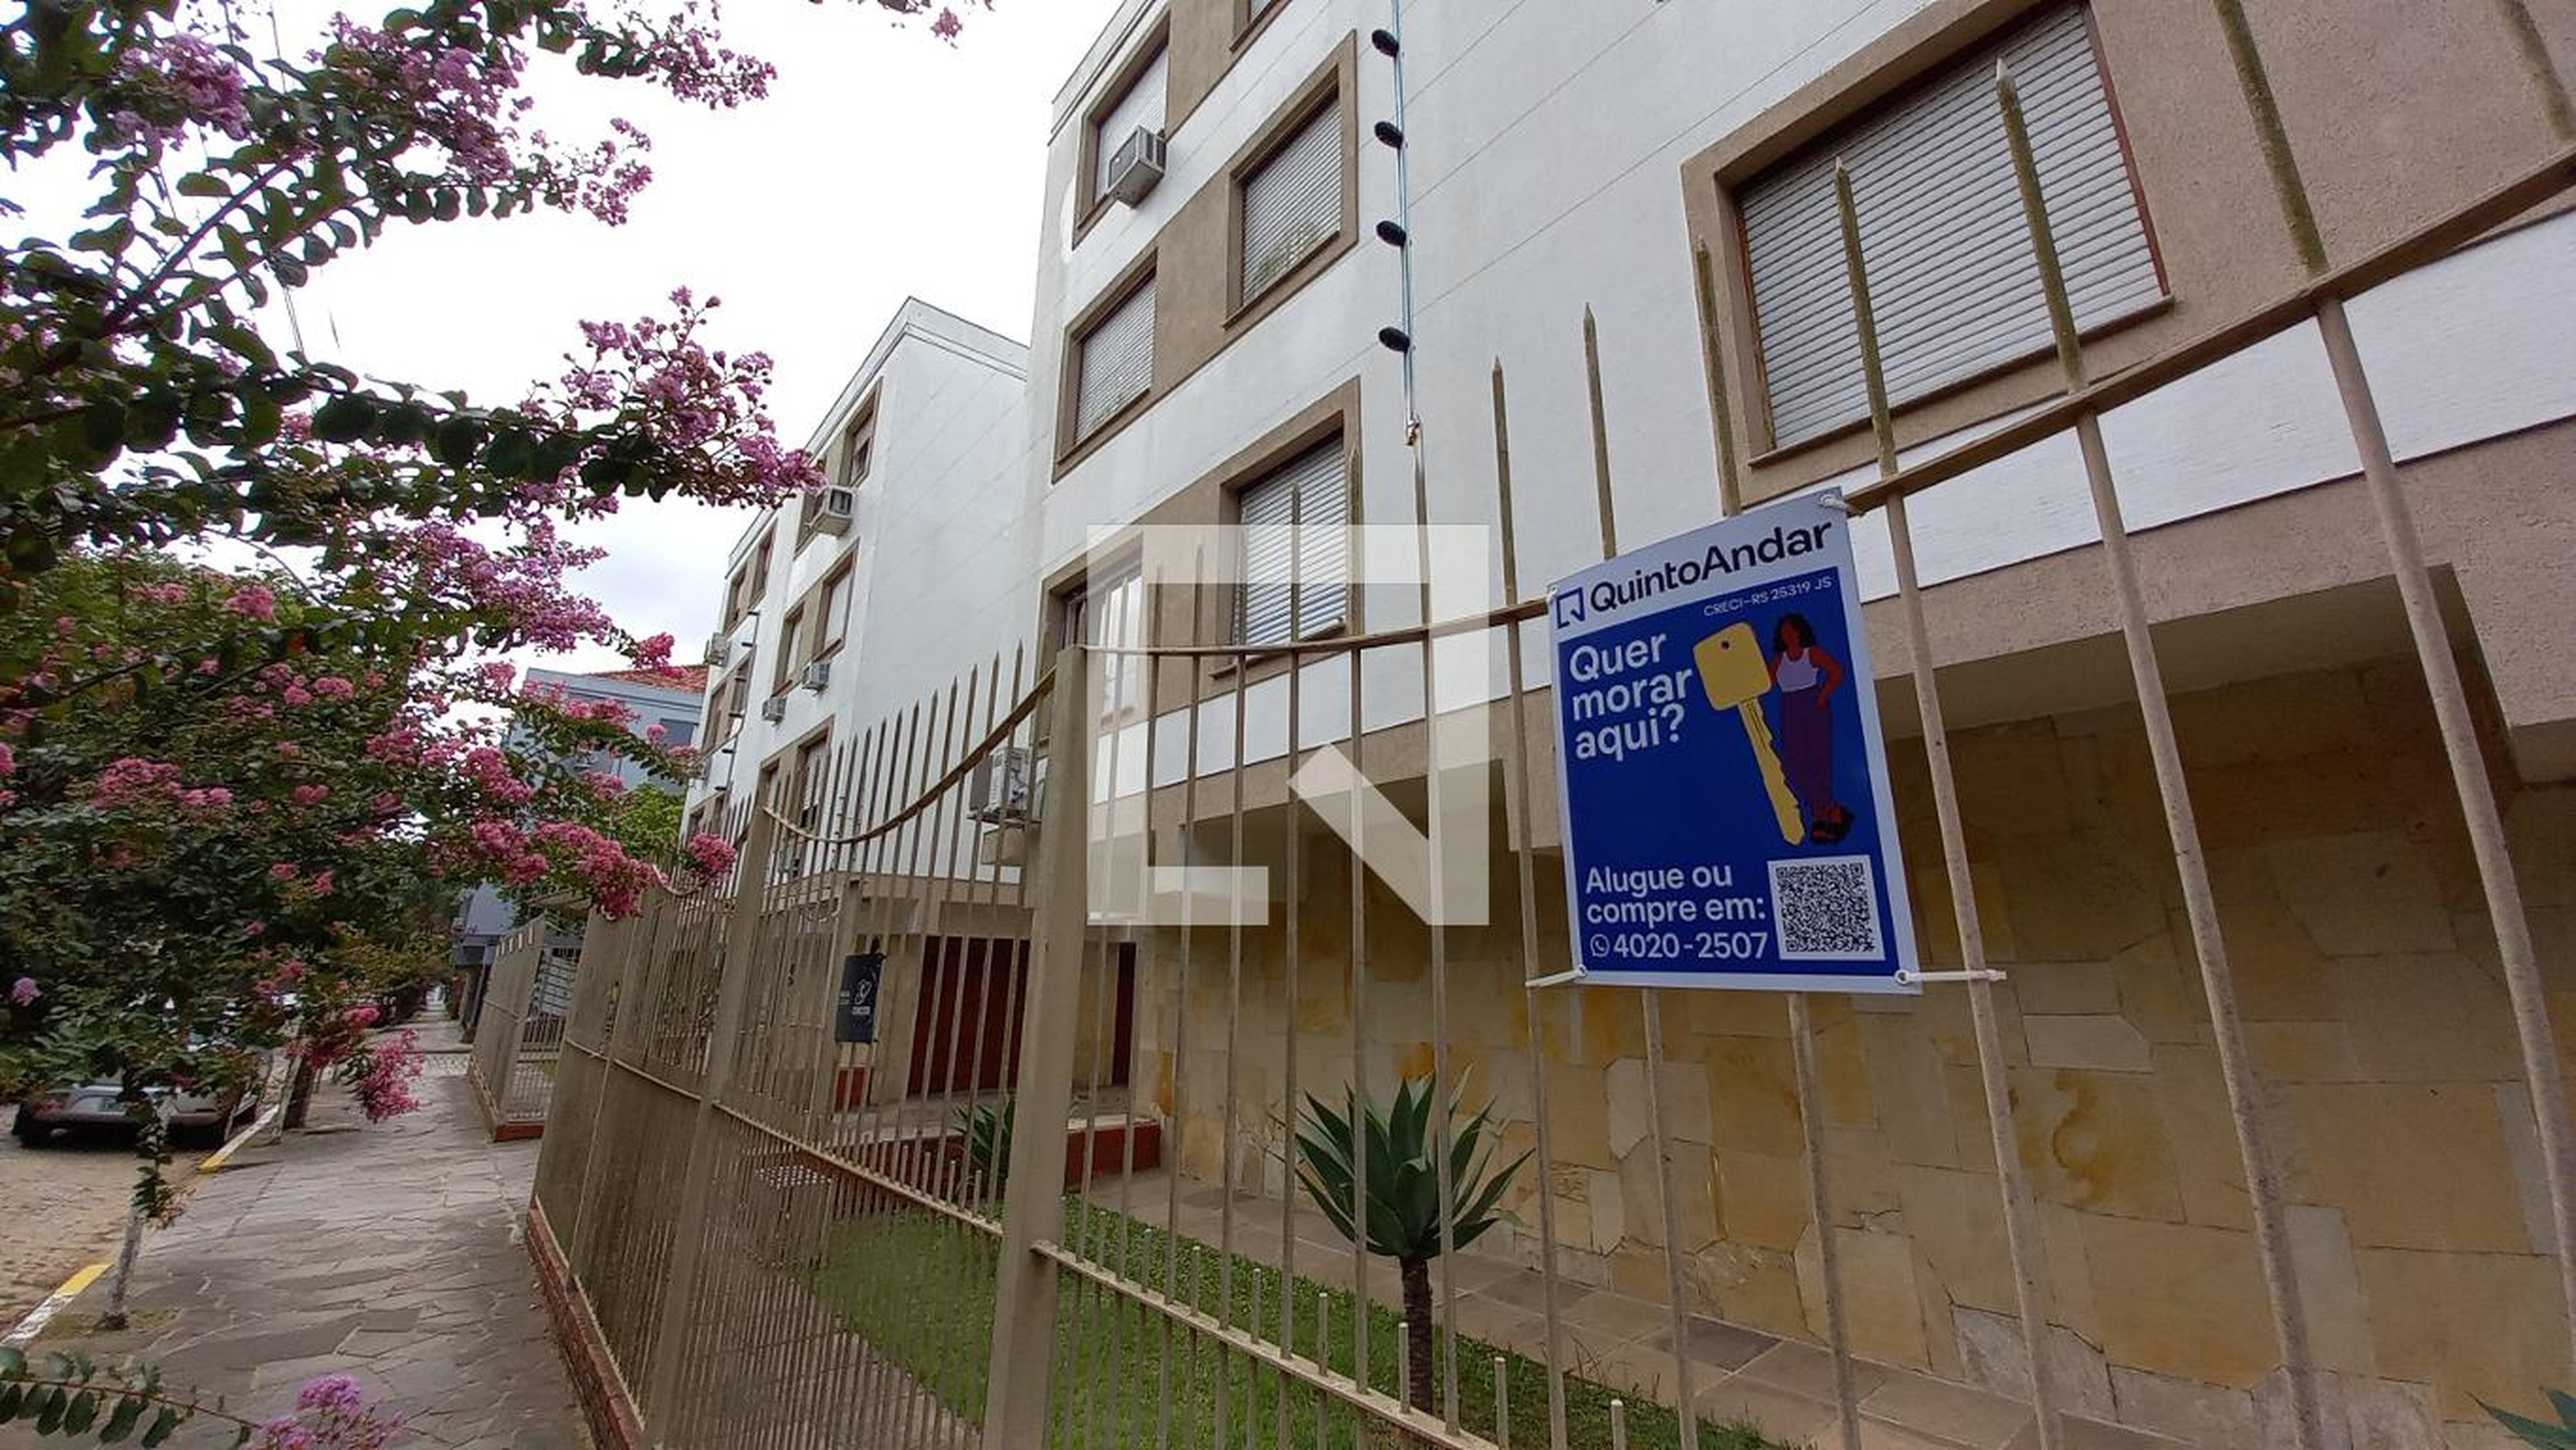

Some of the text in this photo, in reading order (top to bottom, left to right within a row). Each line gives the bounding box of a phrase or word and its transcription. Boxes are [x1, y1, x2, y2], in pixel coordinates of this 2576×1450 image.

[1591, 522, 1832, 611] QuintoAndar
[1771, 580, 1810, 601] 25319
[1815, 576, 1832, 591] JS
[1569, 633, 1666, 682] Quer
[1572, 670, 1691, 721] morar
[1574, 705, 1685, 762] aqui?
[1586, 865, 1732, 897] Alugue ou
[1586, 896, 1766, 928] compre em:
[1613, 932, 1768, 959] 4020-2507
